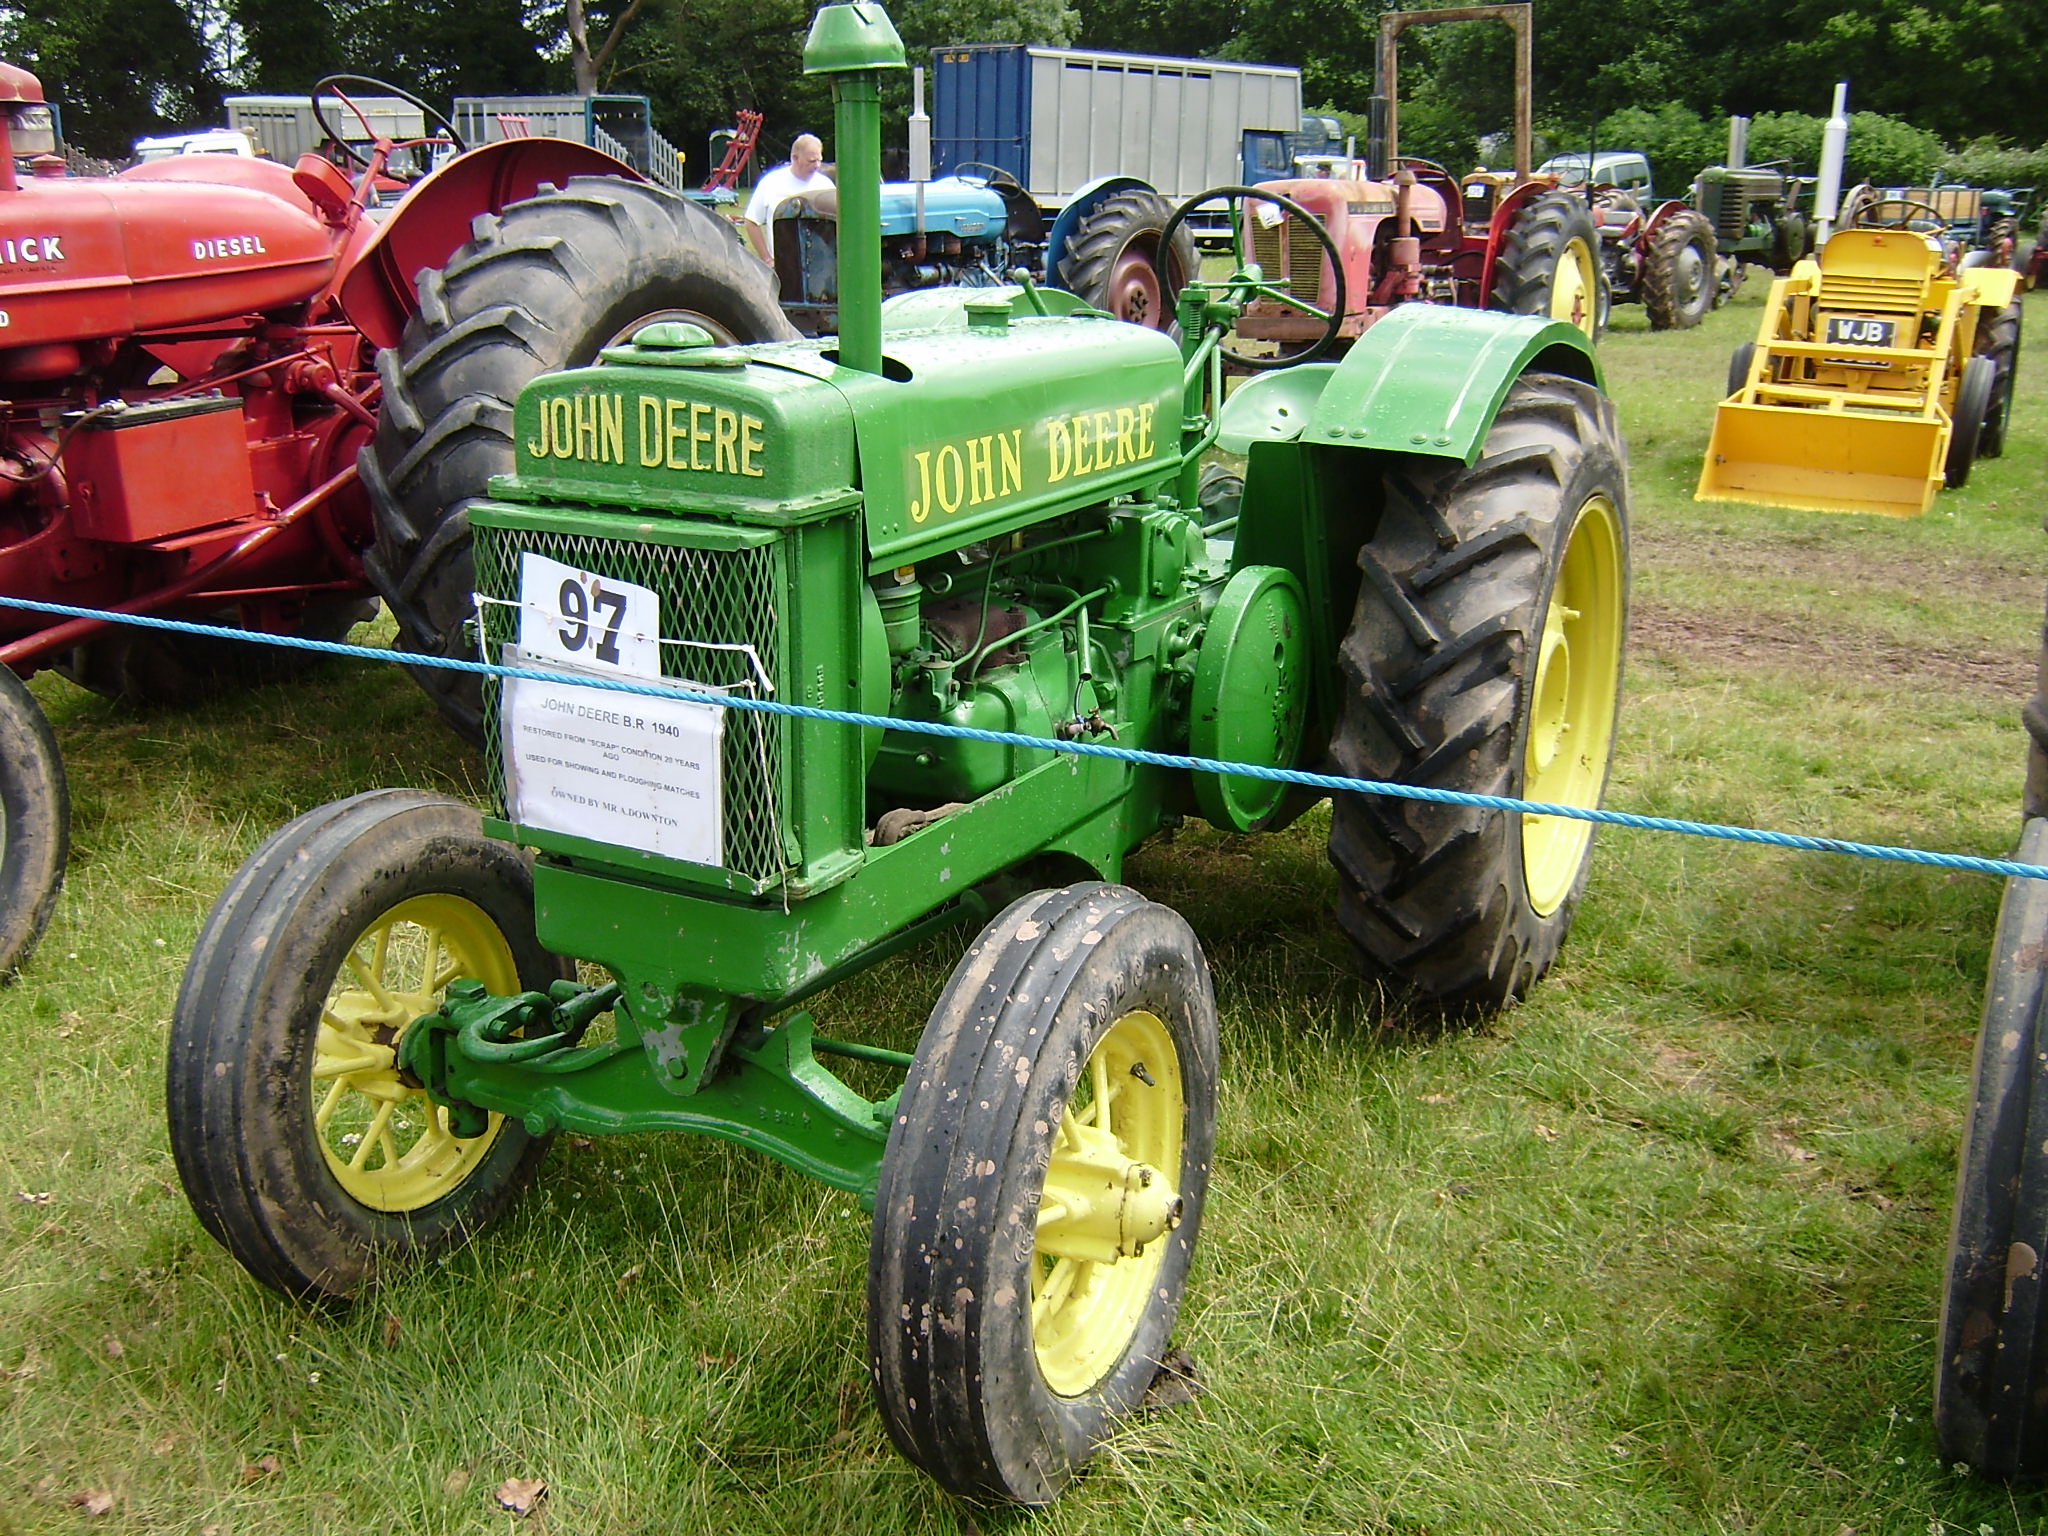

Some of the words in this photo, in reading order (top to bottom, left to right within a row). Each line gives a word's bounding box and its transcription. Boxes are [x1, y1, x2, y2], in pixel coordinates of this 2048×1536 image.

[0, 237, 65, 264] ICK
[194, 236, 266, 260] DIESEL
[1838, 320, 1883, 342] WJB
[527, 394, 624, 465] JOHN
[639, 395, 764, 477] DEERE
[911, 429, 1022, 524] JOHN
[1047, 403, 1156, 483] DEERE
[559, 579, 627, 665] 97
[540, 698, 575, 715] JOHN
[577, 705, 620, 725] DEERE
[623, 715, 645, 731] B.R
[652, 722, 680, 738] 1940
[523, 725, 563, 740] RESTORED
[564, 733, 586, 744] FROM
[621, 746, 663, 762] CONDITION
[674, 758, 700, 771] YEARS
[603, 752, 619, 761] AGO
[525, 753, 546, 763] USED
[547, 757, 563, 767] FOR
[564, 761, 600, 775] SHOWING
[601, 769, 617, 779] AND
[619, 773, 662, 790] PLOUGHING
[663, 784, 700, 799] MATCHES
[551, 789, 586, 804] OWNED
[588, 798, 600, 808] BY
[602, 802, 617, 813] MR
